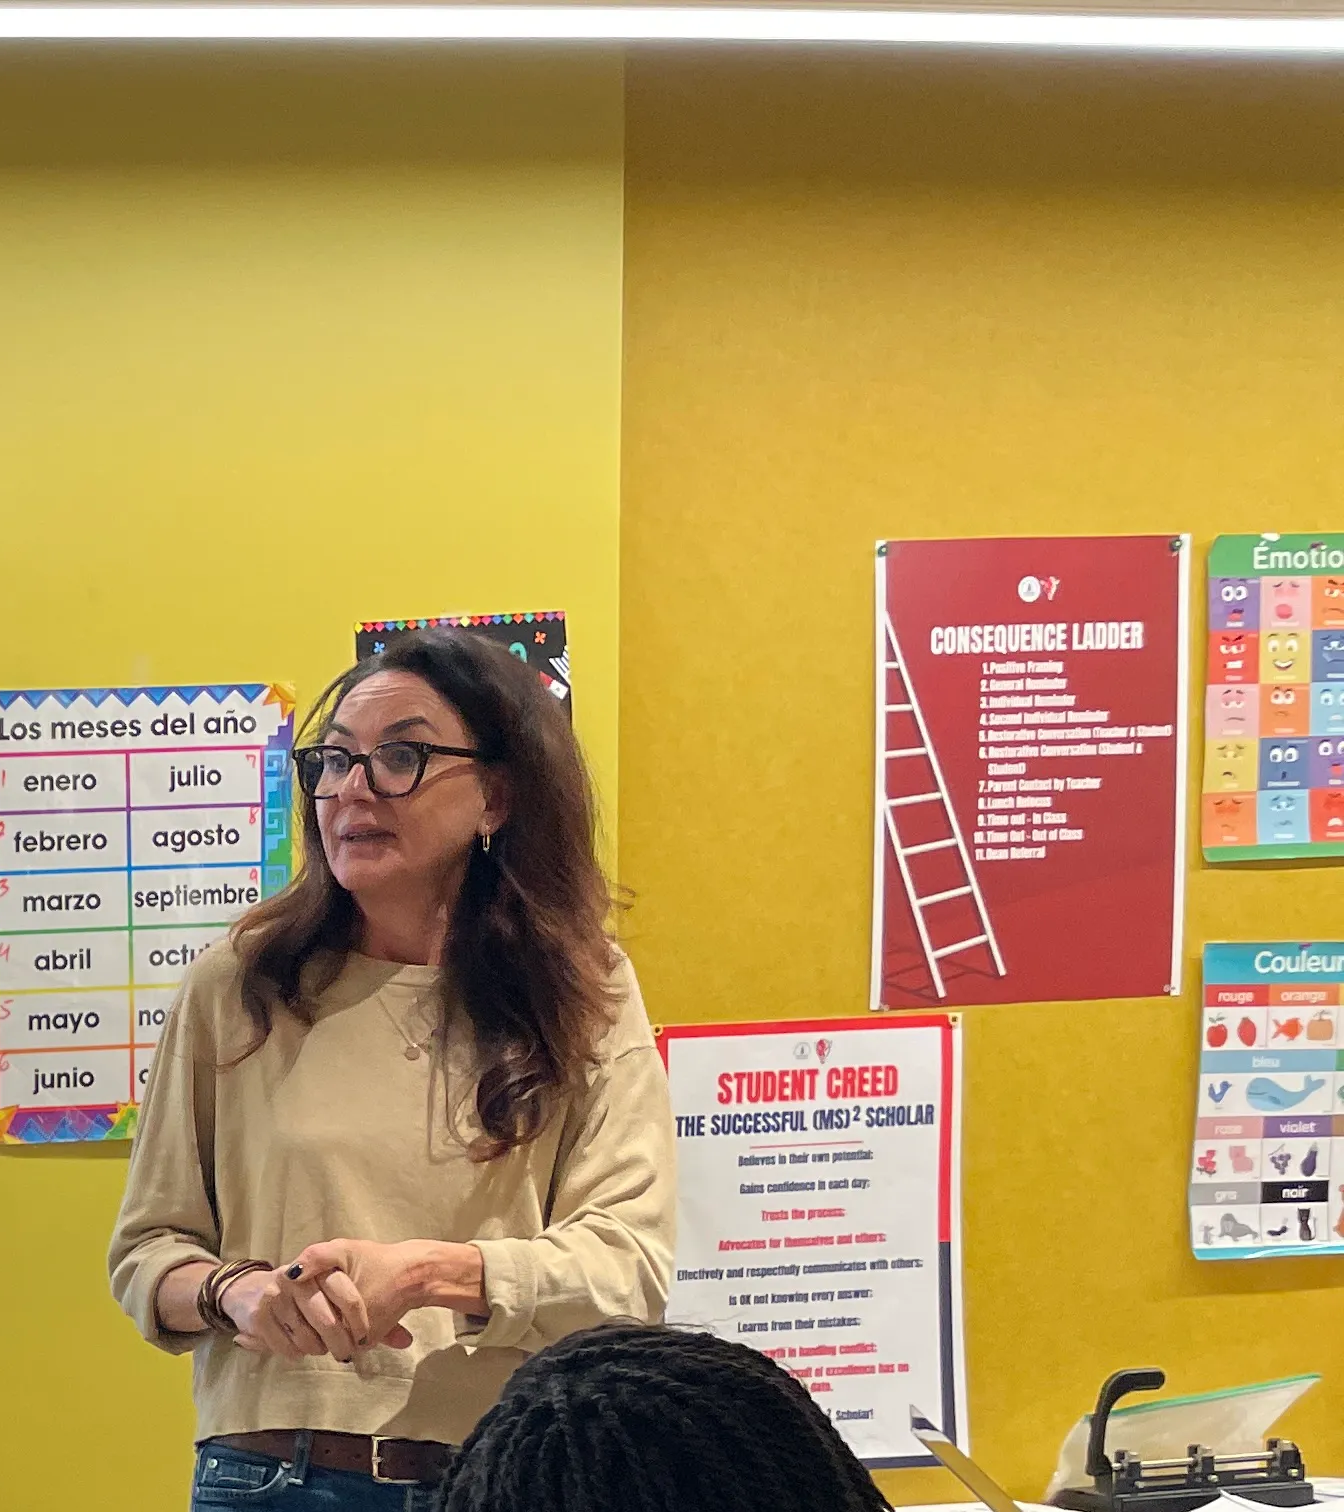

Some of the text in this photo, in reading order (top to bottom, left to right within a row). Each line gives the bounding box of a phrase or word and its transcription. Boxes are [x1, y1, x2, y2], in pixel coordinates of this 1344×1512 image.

[1253, 540, 1344, 569] Émotio
[930, 621, 1144, 655] CONSEQUENCE LADDER
[50, 715, 142, 739] meses
[150, 711, 195, 737] del
[204, 709, 257, 735] año
[23, 772, 97, 792] enero
[168, 765, 222, 793] julio
[13, 830, 108, 854] febrero
[151, 824, 240, 855] agosto
[22, 892, 102, 913] marzo
[133, 884, 259, 911] septiembre
[34, 948, 92, 971] abril
[1254, 950, 1344, 974] Couleur
[1217, 991, 1254, 1005] rouge
[1281, 990, 1328, 1004] orange
[28, 1010, 100, 1034] mayo
[32, 1067, 95, 1094] junio
[717, 1065, 899, 1105] STUDENT CREED
[675, 1115, 706, 1137] THE
[711, 1111, 808, 1135] SUCCESSFUL
[865, 1104, 935, 1127] SCHOLAR
[1279, 1121, 1316, 1134] violet
[1281, 1186, 1308, 1199] noir
[677, 1264, 800, 1281] Effectively and respectfully
